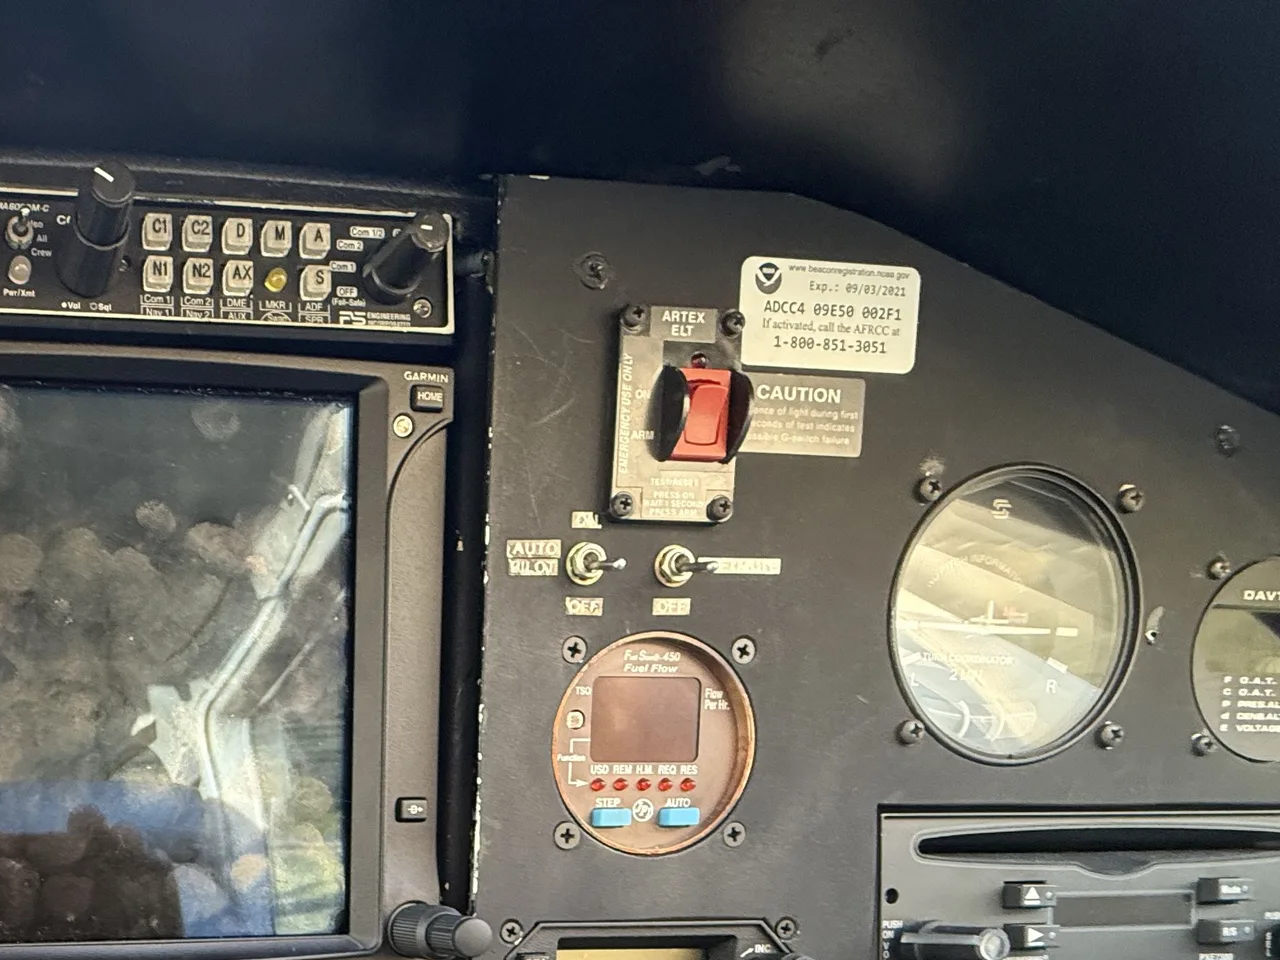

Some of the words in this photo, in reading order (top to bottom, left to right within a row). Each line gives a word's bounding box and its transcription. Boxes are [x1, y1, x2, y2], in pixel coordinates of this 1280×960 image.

[152, 218, 168, 233] C1
[191, 221, 210, 235] C2
[352, 228, 369, 237] Com
[153, 263, 168, 276] N1
[192, 264, 211, 278] N2
[232, 266, 252, 280] AX
[339, 288, 355, 296] OFF
[809, 281, 839, 293] Exp.:
[845, 282, 906, 297] 09/03/2021
[227, 299, 247, 307] DME
[764, 300, 805, 315] ADCC4
[813, 302, 855, 318] 09E50
[862, 305, 902, 320] 002F1
[662, 312, 705, 324] ARTEX
[671, 325, 694, 336] ELT
[762, 318, 770, 329] If
[773, 318, 816, 334] activated,
[818, 321, 835, 332] call
[837, 322, 850, 334] the
[853, 323, 889, 336] AFRCC
[891, 327, 900, 336] at
[774, 335, 887, 354] 1-800-851-3051
[404, 371, 448, 383] GARMIN
[757, 385, 841, 404] CAUTION
[623, 664, 649, 672] Fuel
[650, 664, 678, 673] Flow
[680, 765, 698, 775] RES
[596, 798, 621, 808] STEP
[665, 798, 690, 808] AUTO
[755, 944, 770, 953] INC
